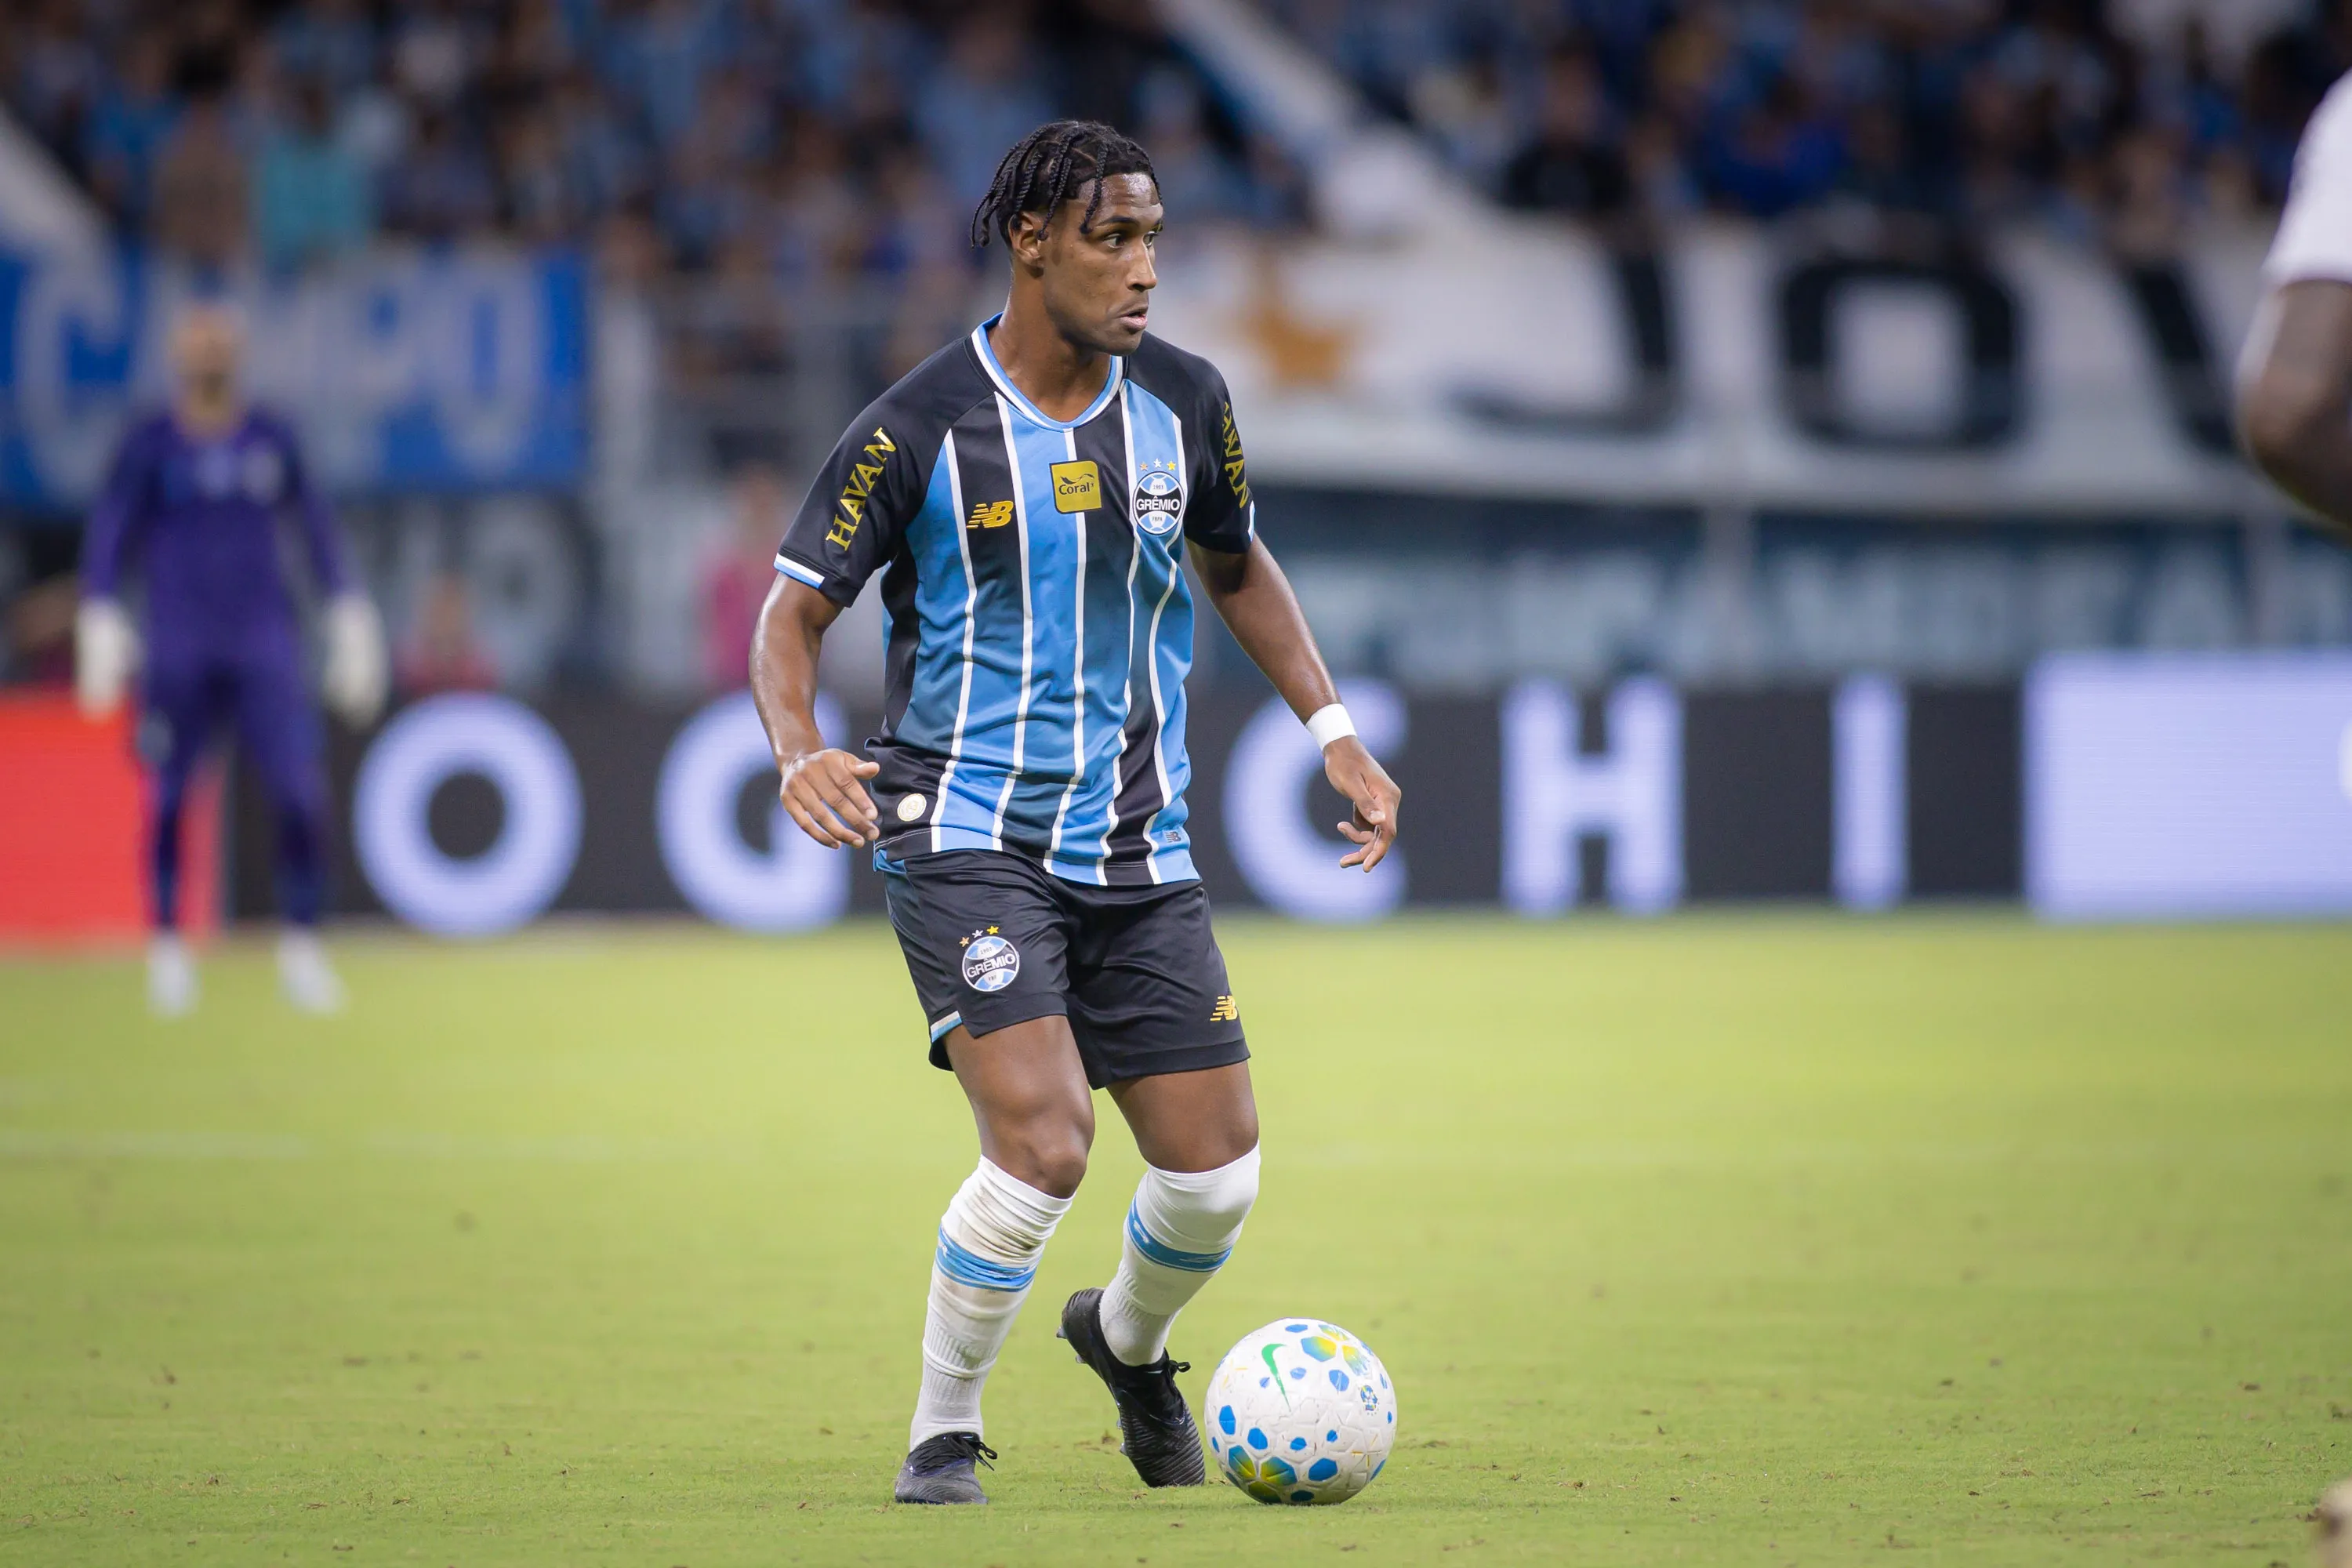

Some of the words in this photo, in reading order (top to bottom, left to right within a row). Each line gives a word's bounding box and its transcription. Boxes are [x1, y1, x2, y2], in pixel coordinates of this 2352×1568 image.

[826, 426, 896, 551] HAVAN
[1058, 481, 1090, 495] Coral
[1136, 495, 1181, 511] GRÊMIO
[353, 684, 1910, 937] OGCHI
[966, 953, 1016, 978] GRÊMIO
